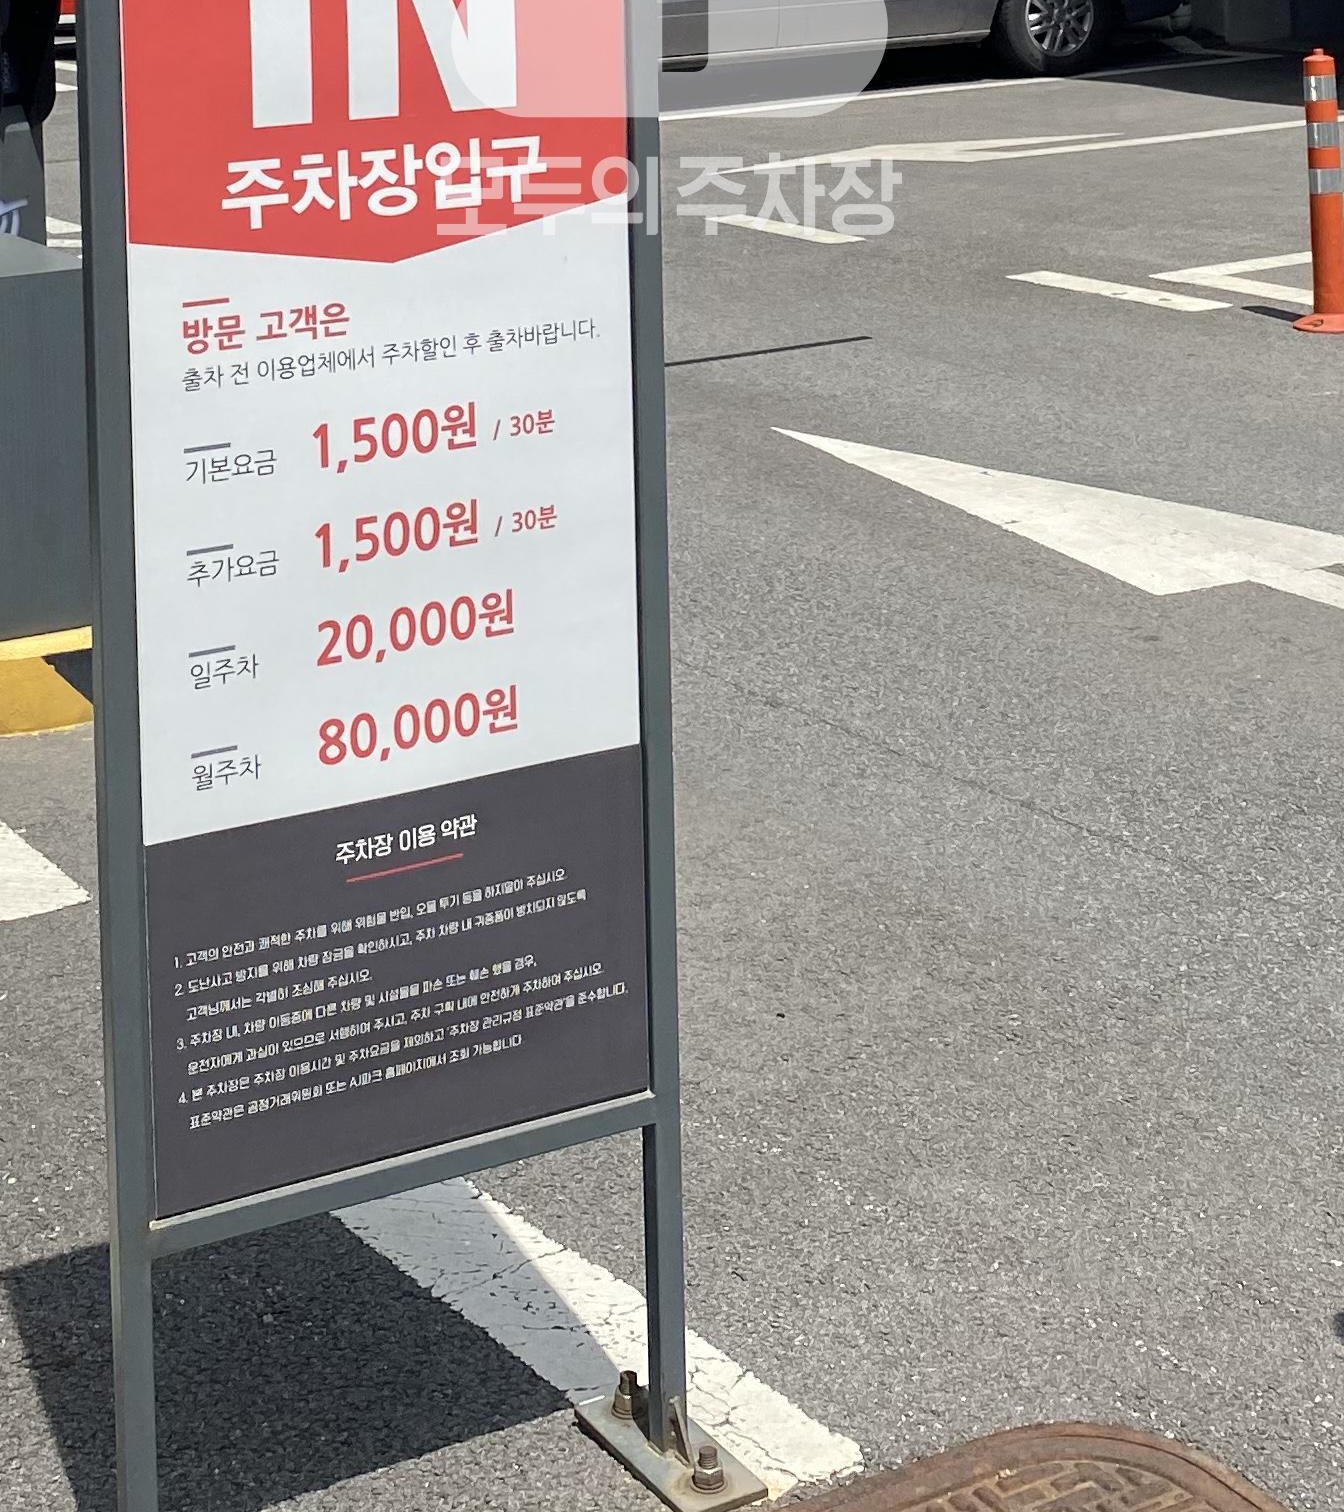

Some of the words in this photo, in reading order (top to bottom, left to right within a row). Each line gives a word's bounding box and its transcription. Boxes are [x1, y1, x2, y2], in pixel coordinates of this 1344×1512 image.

[221, 135, 547, 230] 주차장입구
[182, 315, 246, 355] 방문
[256, 302, 351, 345] 고객은
[182, 361, 224, 392] 출차
[230, 362, 251, 386] 전
[257, 344, 376, 382] 이용업체에서
[382, 335, 458, 368] 주차할인
[462, 331, 484, 357] 후
[486, 318, 601, 352] 출차바랍니다.
[185, 448, 278, 484] 기본요금
[312, 402, 479, 474] 1,500원
[493, 418, 501, 441] /
[509, 409, 556, 438] 30분
[187, 550, 280, 587] 추가요금
[314, 499, 480, 573] 1,500원
[494, 516, 503, 538] /
[511, 504, 558, 534] 30분
[189, 653, 260, 691] 일주차
[316, 588, 515, 667] 20,000원
[191, 755, 262, 792] 월주차
[318, 685, 519, 767] 80,000원
[335, 832, 393, 866] 주차장
[399, 821, 436, 853] 이용
[441, 813, 478, 842] 약관
